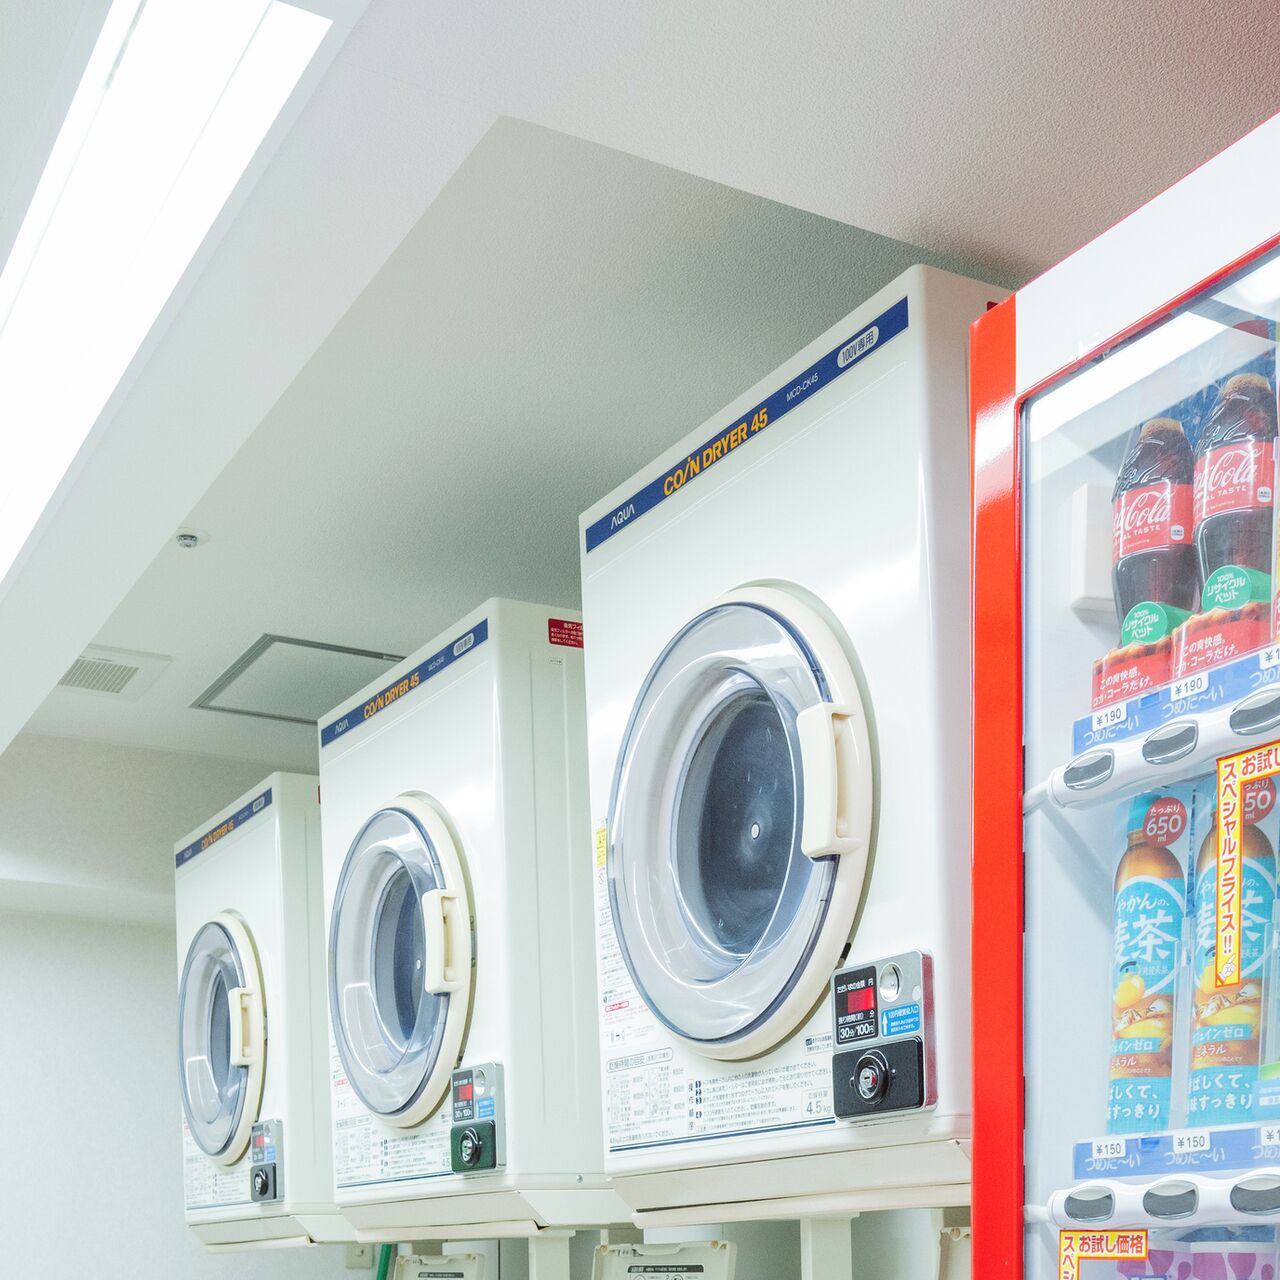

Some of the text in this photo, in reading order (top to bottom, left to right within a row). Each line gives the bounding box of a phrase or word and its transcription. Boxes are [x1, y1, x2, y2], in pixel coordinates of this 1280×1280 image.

[663, 407, 769, 497] COIN DRYER 45
[611, 504, 635, 530] AQUA
[363, 672, 420, 719] COIN DRYER 45
[1175, 679, 1203, 696] ¥190
[1096, 708, 1122, 725] ¥190
[1145, 815, 1181, 838] 650
[1078, 1235, 1144, 1254] お試し価格
